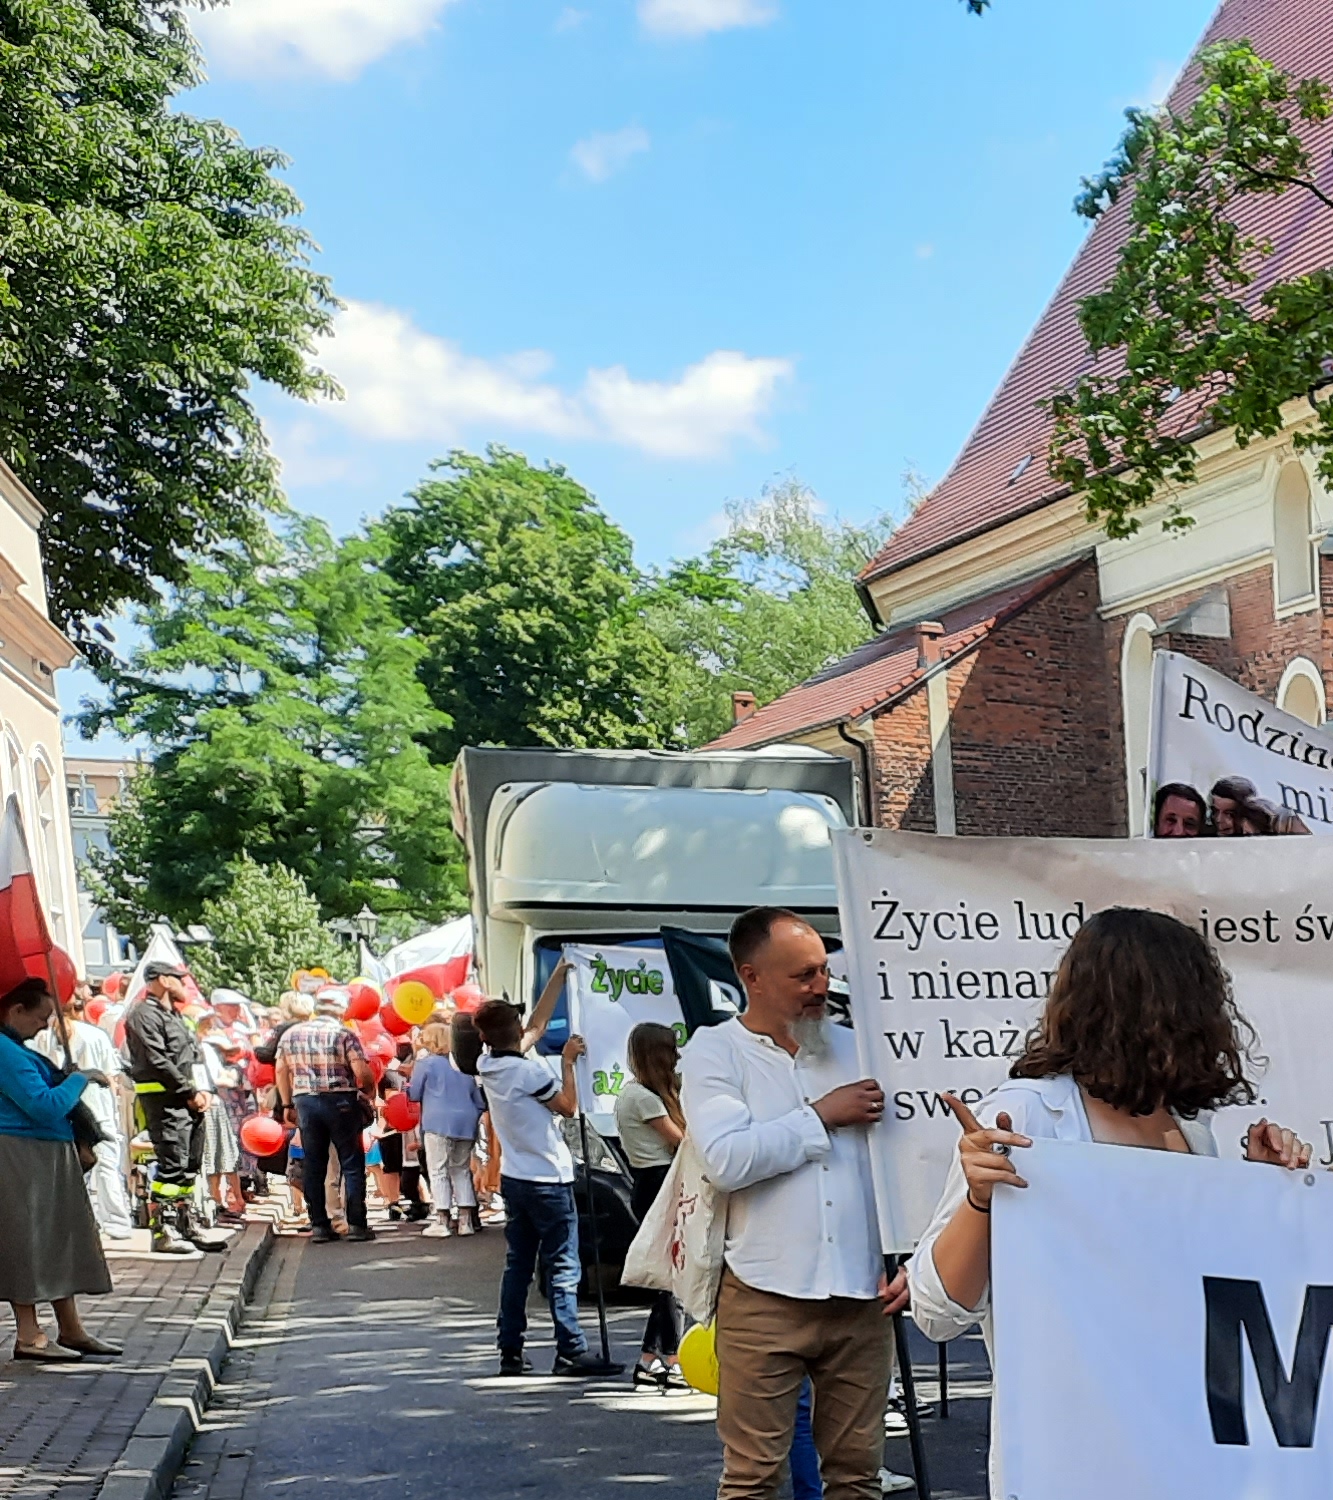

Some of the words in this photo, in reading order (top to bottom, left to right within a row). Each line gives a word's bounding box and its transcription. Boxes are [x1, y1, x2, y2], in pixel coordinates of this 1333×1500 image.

[871, 890, 999, 951] Życie
[1199, 908, 1281, 943] jest
[590, 952, 664, 1002] Życie
[877, 960, 895, 1000] i
[883, 1030, 926, 1060] w
